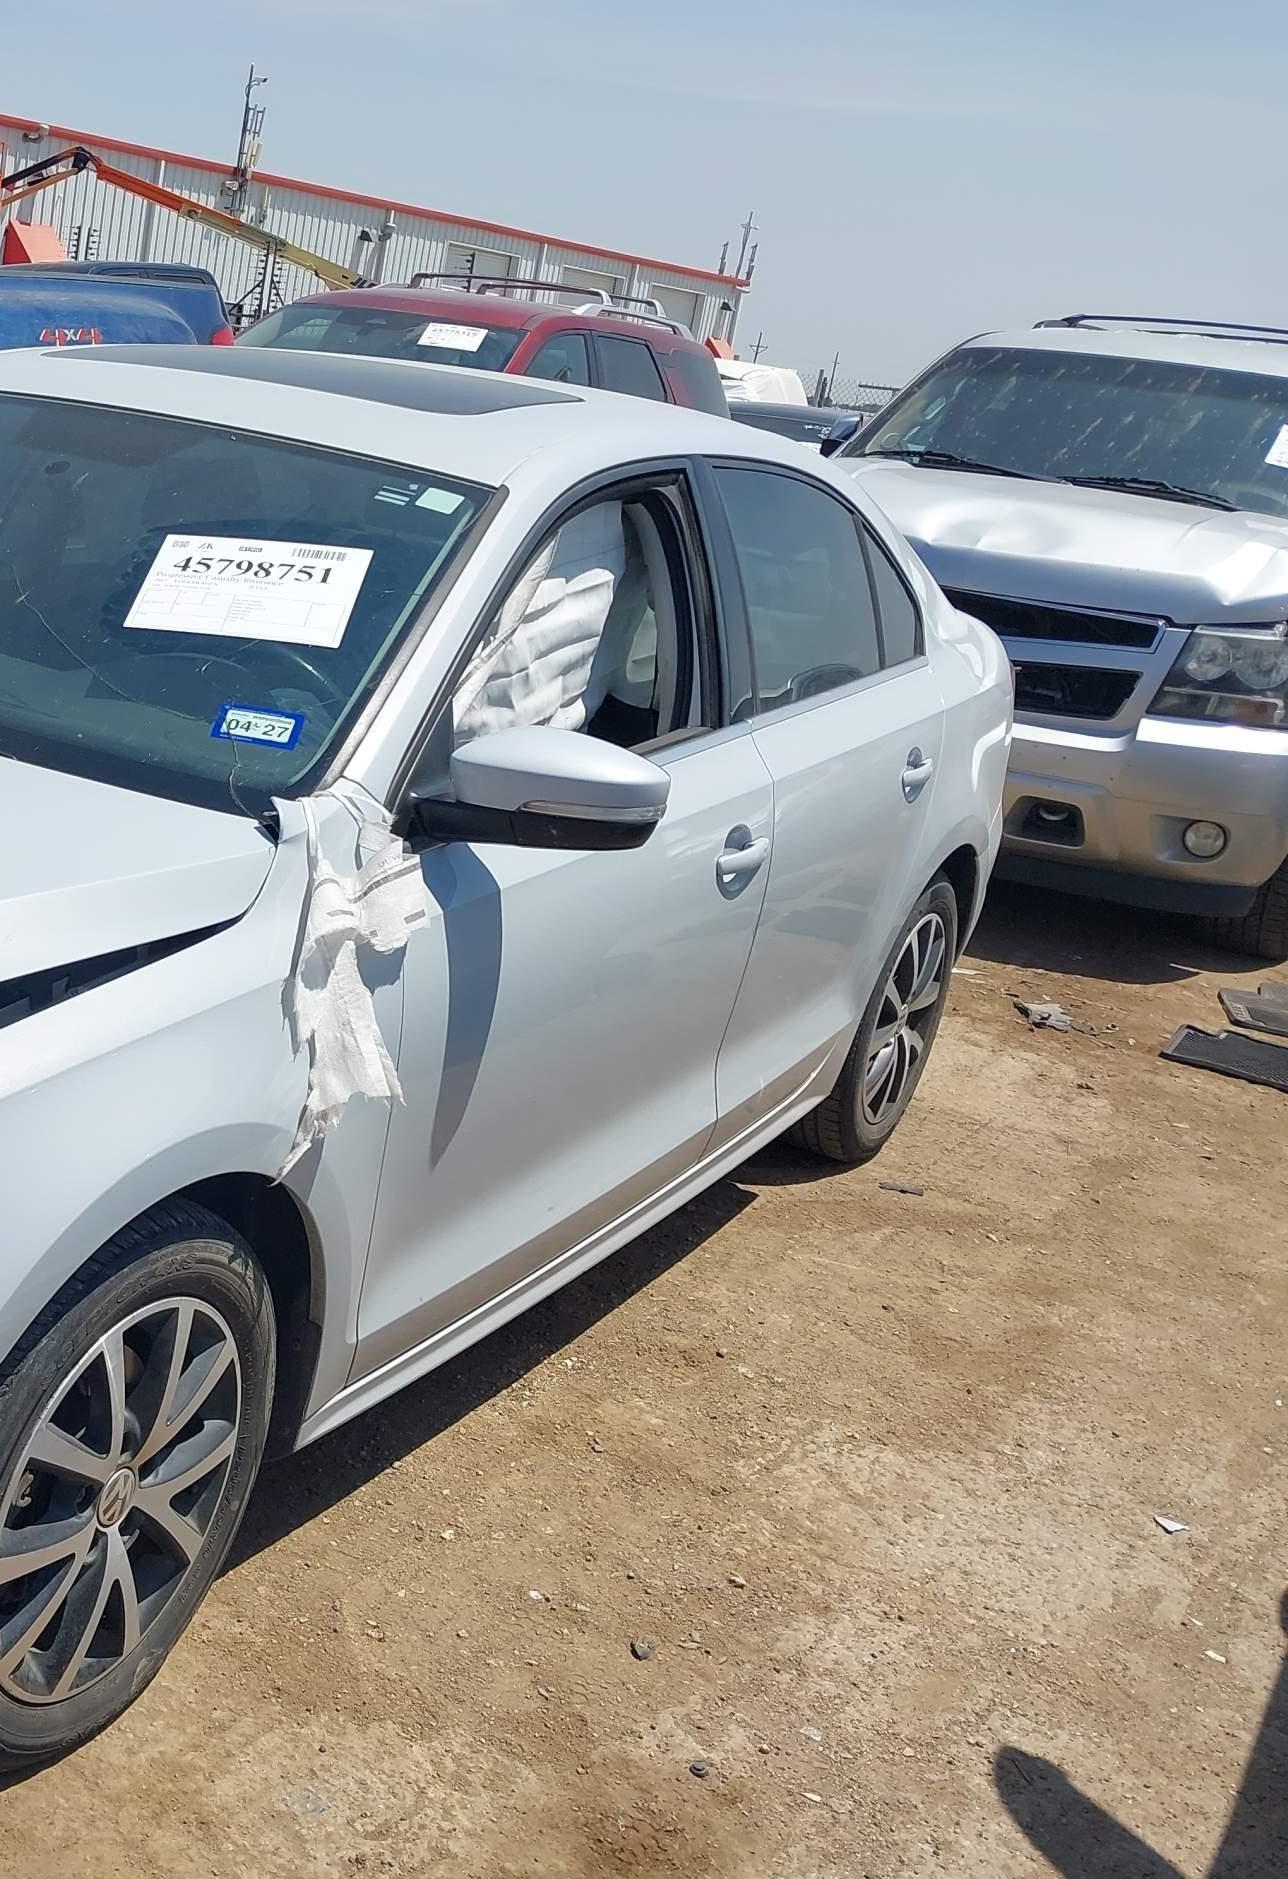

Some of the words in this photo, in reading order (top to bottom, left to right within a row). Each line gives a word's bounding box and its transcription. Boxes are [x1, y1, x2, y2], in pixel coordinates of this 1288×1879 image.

[173, 556, 332, 585] 45798751
[227, 718, 252, 732] 04
[261, 724, 290, 738] 27
